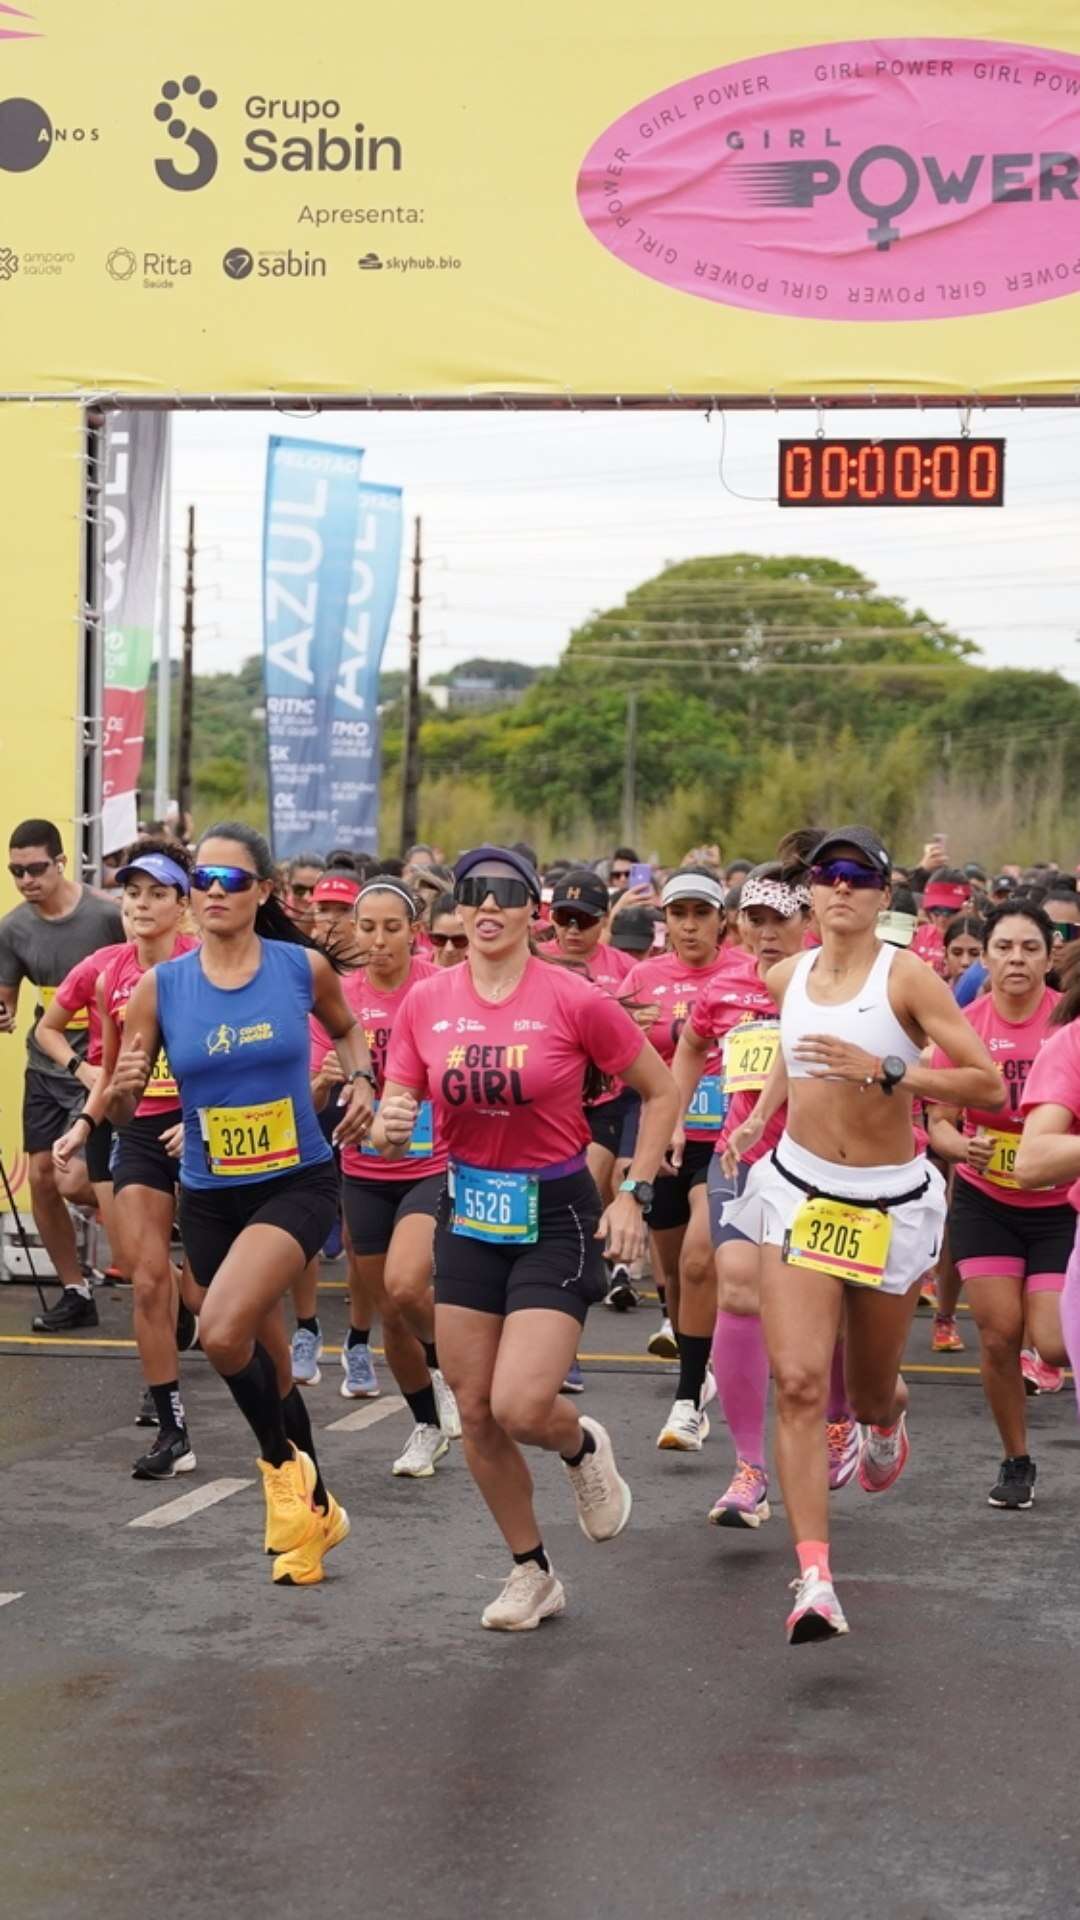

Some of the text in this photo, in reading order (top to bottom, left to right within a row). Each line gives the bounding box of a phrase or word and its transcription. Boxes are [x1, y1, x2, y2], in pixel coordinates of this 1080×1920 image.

[814, 59, 954, 81] GIRL POWER
[973, 63, 1080, 96] GIRL POW
[244, 95, 341, 123] Grupo
[639, 75, 770, 139] GIRL POWER
[37, 128, 100, 142] ANOS
[243, 123, 402, 172] Sabin
[726, 128, 842, 150] GIRL
[602, 147, 678, 264] GIRL POWER
[722, 145, 1080, 251] POWER
[298, 205, 425, 228] Apresenta:
[23, 252, 76, 264] amparo
[143, 253, 193, 275] Rita
[257, 249, 327, 277] sabin
[386, 255, 462, 272] skyhub.bio
[143, 278, 174, 289] Saúde
[694, 259, 828, 301] GIRL POWER
[847, 280, 987, 304] GIRL POWER
[785, 446, 997, 499] 00:00:00
[265, 479, 328, 685] AZUL
[442, 1069, 534, 1106] GIRL
[221, 1124, 270, 1156] 3214
[464, 1188, 511, 1224] 5526
[806, 1219, 862, 1259] 3205
